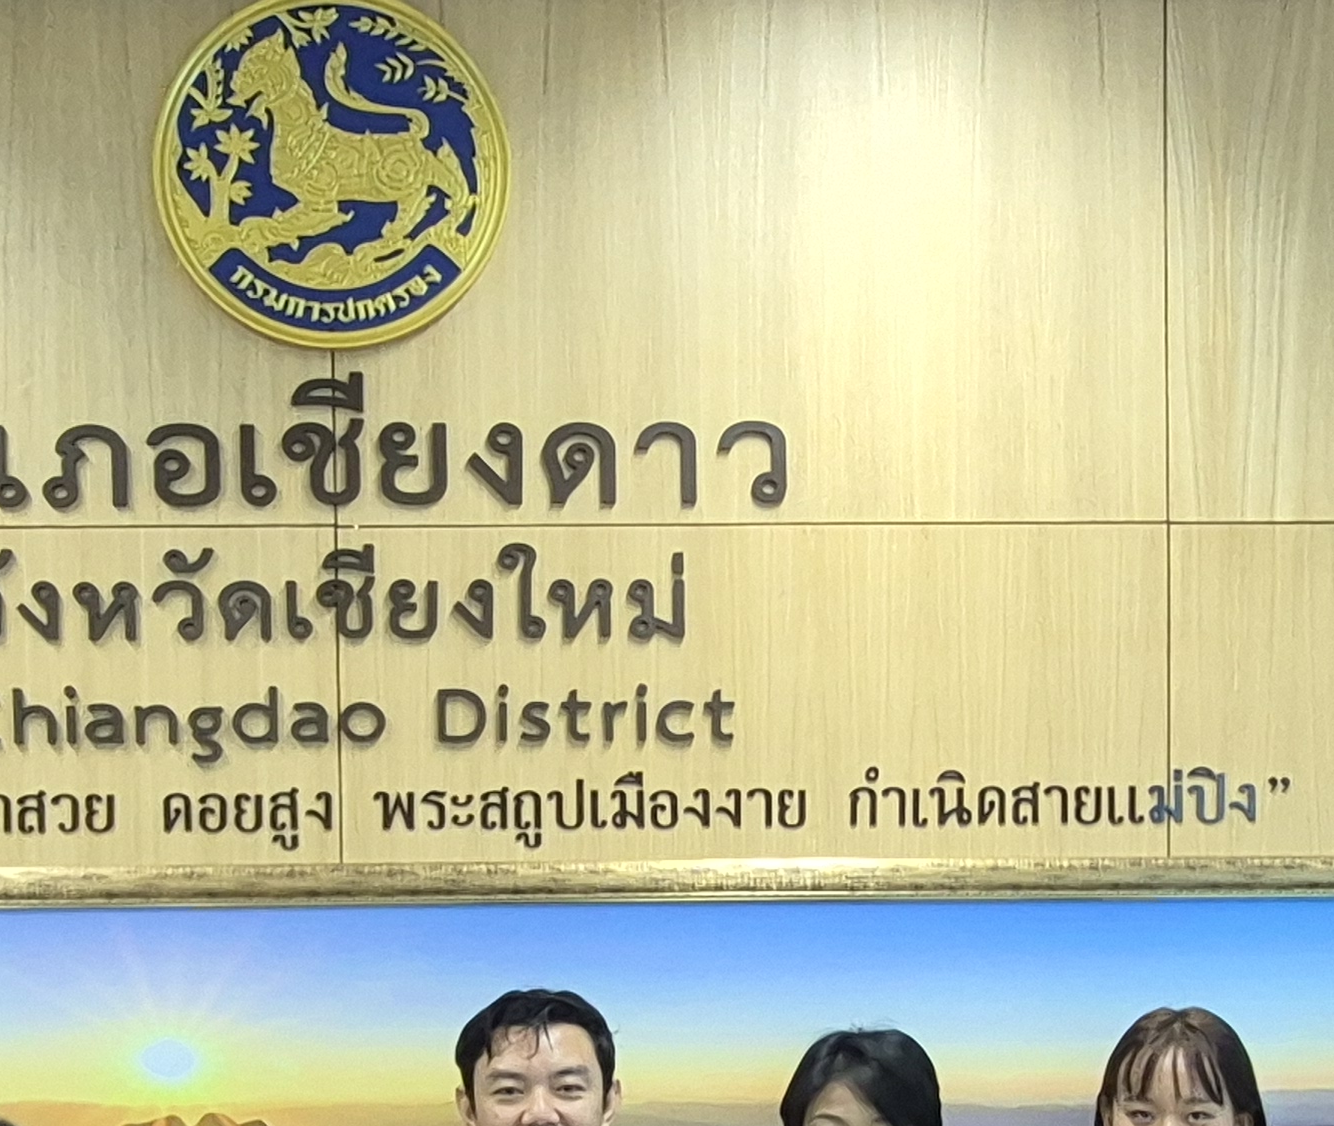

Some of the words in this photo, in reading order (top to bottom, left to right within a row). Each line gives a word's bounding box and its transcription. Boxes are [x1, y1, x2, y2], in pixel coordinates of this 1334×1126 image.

[228, 263, 443, 324] กรมการปกครอง
[436, 683, 736, 745] District
[162, 787, 333, 852] ดอยสูง
[372, 770, 807, 850] พระสถูปเมืองงาย
